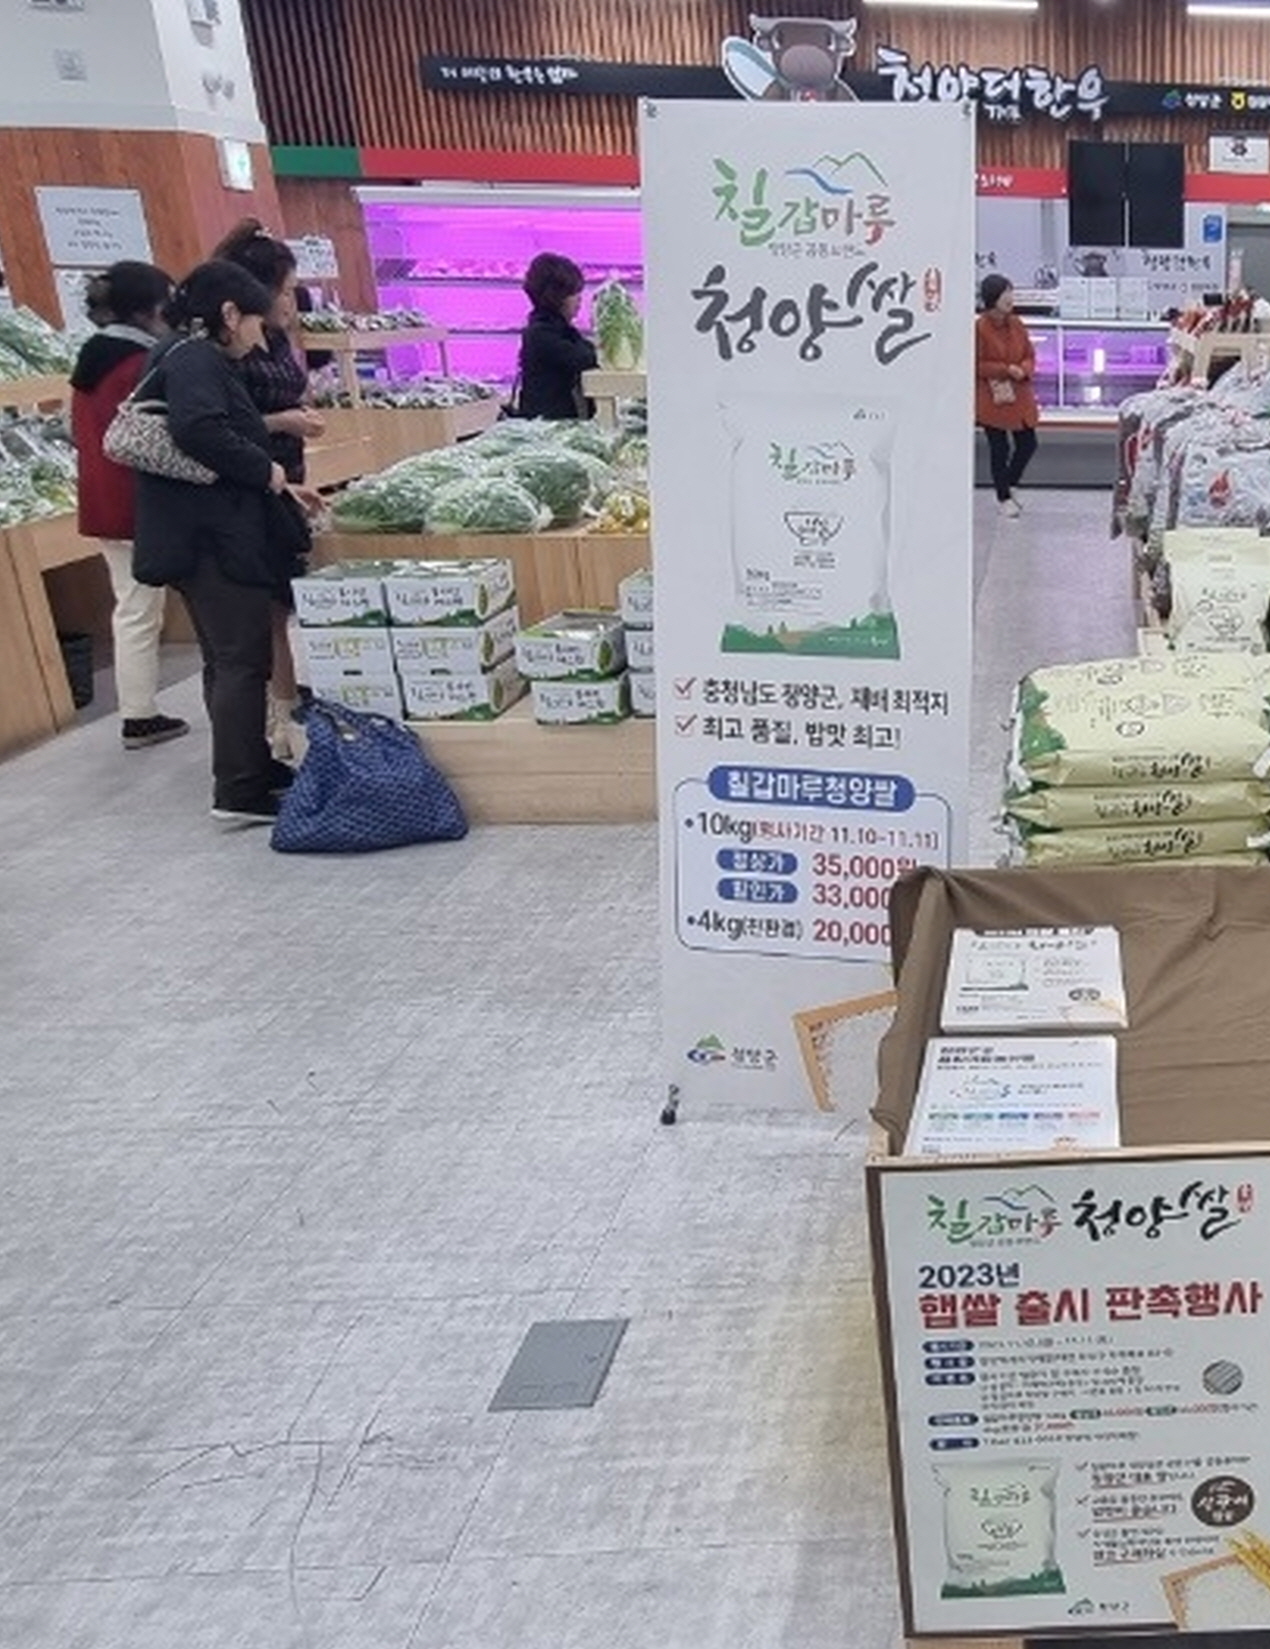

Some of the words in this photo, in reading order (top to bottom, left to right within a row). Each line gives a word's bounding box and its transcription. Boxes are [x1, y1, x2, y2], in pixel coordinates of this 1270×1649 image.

[712, 158, 896, 247] 칠갑마루
[691, 261, 931, 364] 청양쌀
[703, 679, 778, 707] 충청남도
[781, 683, 844, 710] 청양군,
[850, 686, 890, 713] 재배
[893, 689, 949, 716] 최적지
[703, 716, 745, 740] 최고
[751, 718, 798, 745] 품질,
[805, 721, 847, 748] 밥맛
[927, 1194, 1062, 1244] 칠갑마루
[1072, 1181, 1241, 1242] 청양쌀
[918, 1262, 1021, 1290] 2023년
[918, 1290, 1002, 1330] 햅쌀
[1014, 1288, 1090, 1327] 출시
[1105, 1281, 1263, 1322] 판촉행사
